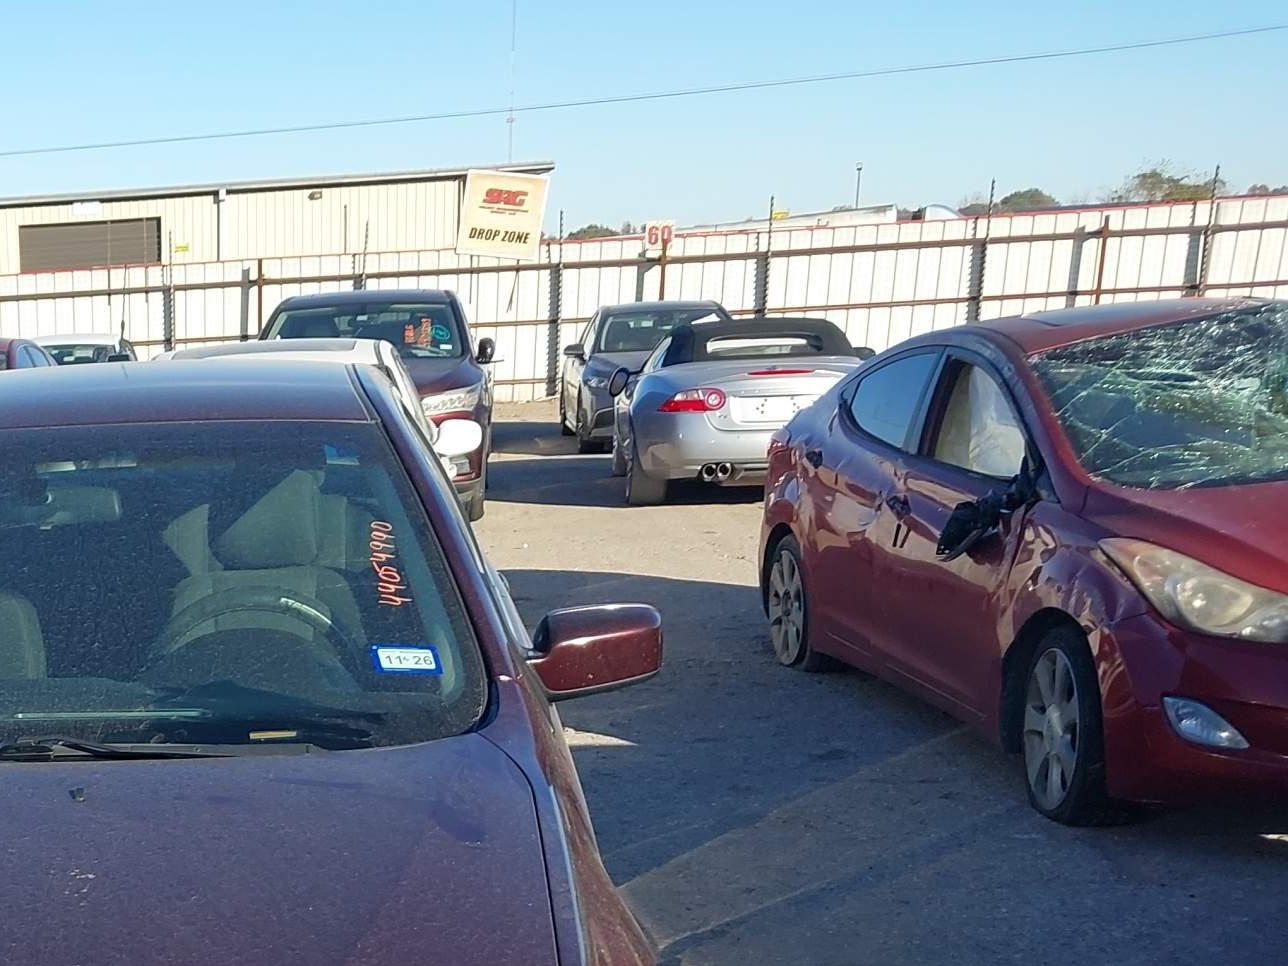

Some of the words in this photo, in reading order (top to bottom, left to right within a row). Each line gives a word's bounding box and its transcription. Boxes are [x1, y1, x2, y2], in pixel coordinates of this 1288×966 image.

[469, 227, 500, 241] DROP
[501, 230, 530, 244] ZONE
[648, 225, 673, 245] 60
